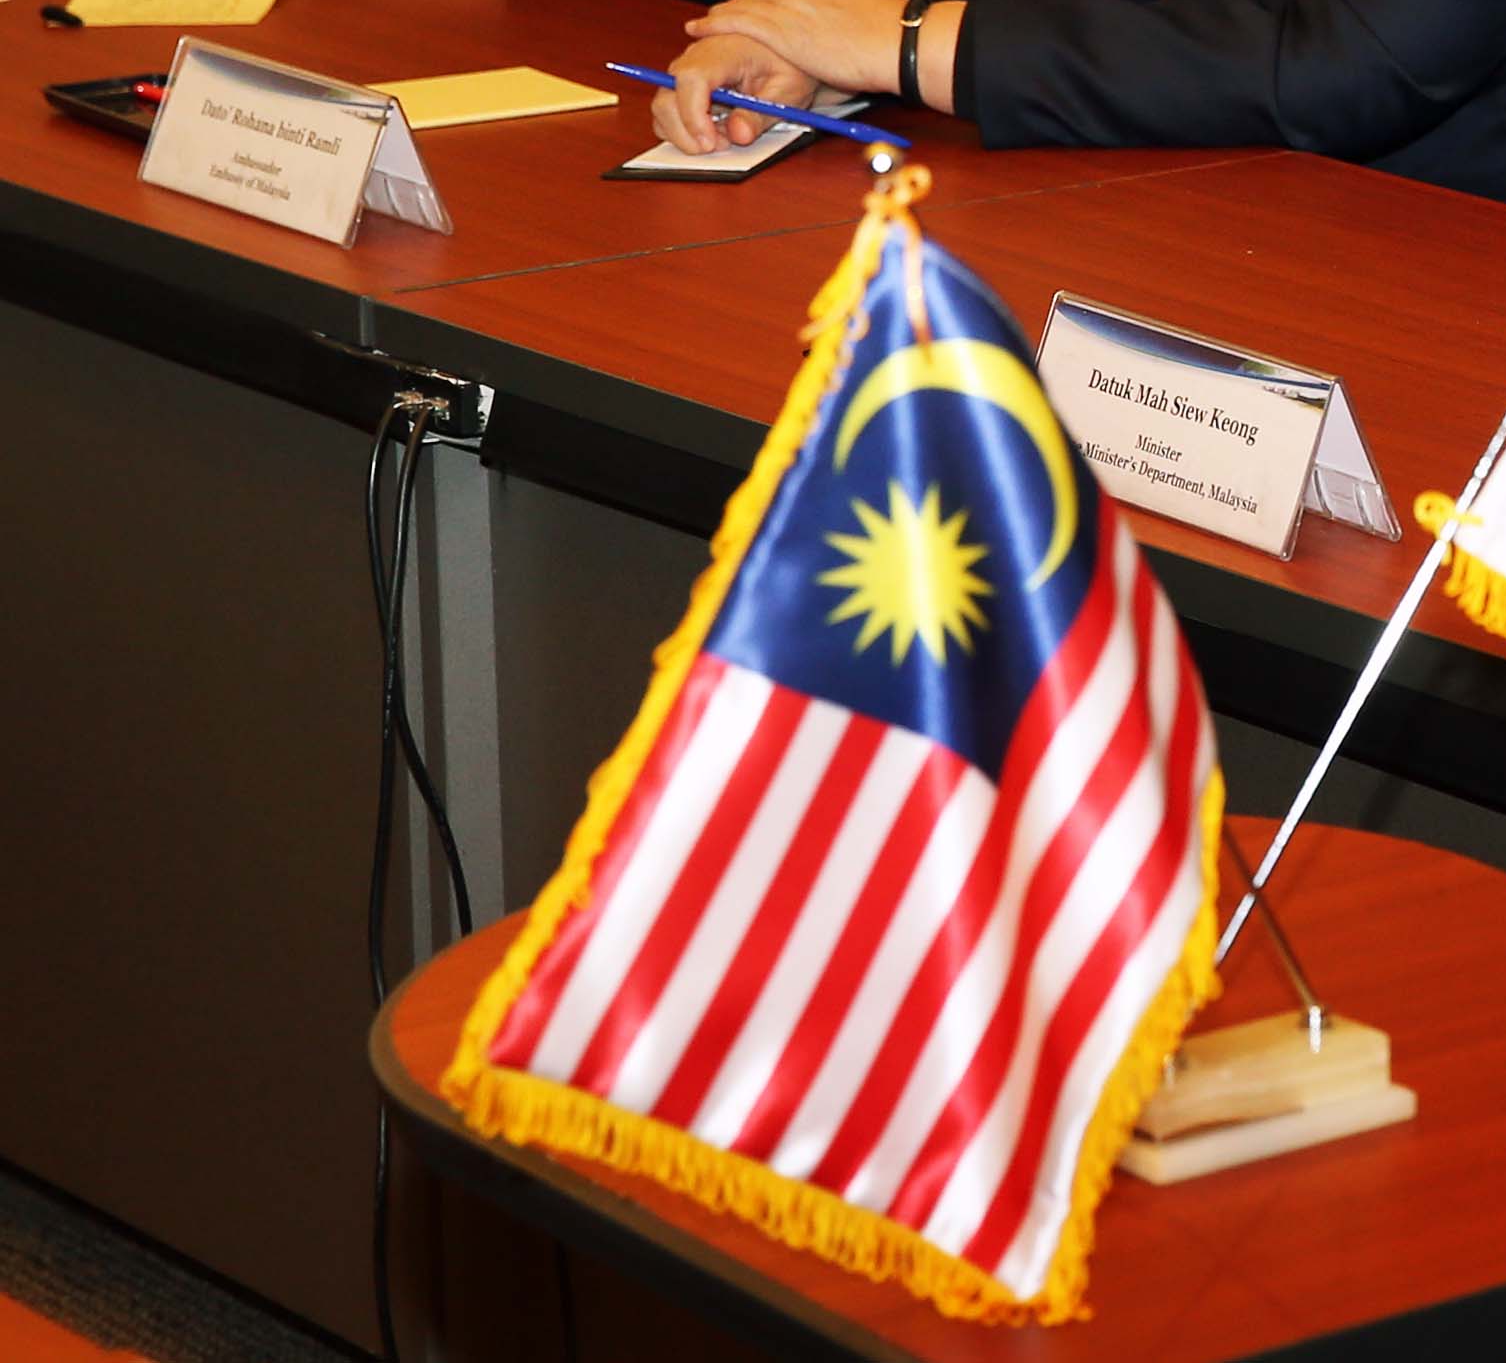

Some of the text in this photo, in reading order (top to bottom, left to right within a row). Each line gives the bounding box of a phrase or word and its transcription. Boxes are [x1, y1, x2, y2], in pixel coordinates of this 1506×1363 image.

[1088, 368, 1260, 446] Datuk Mah Siew Keong
[1135, 434, 1183, 463] Minister
[1138, 460, 1206, 498] Department,
[1208, 483, 1259, 515] Malaysia
